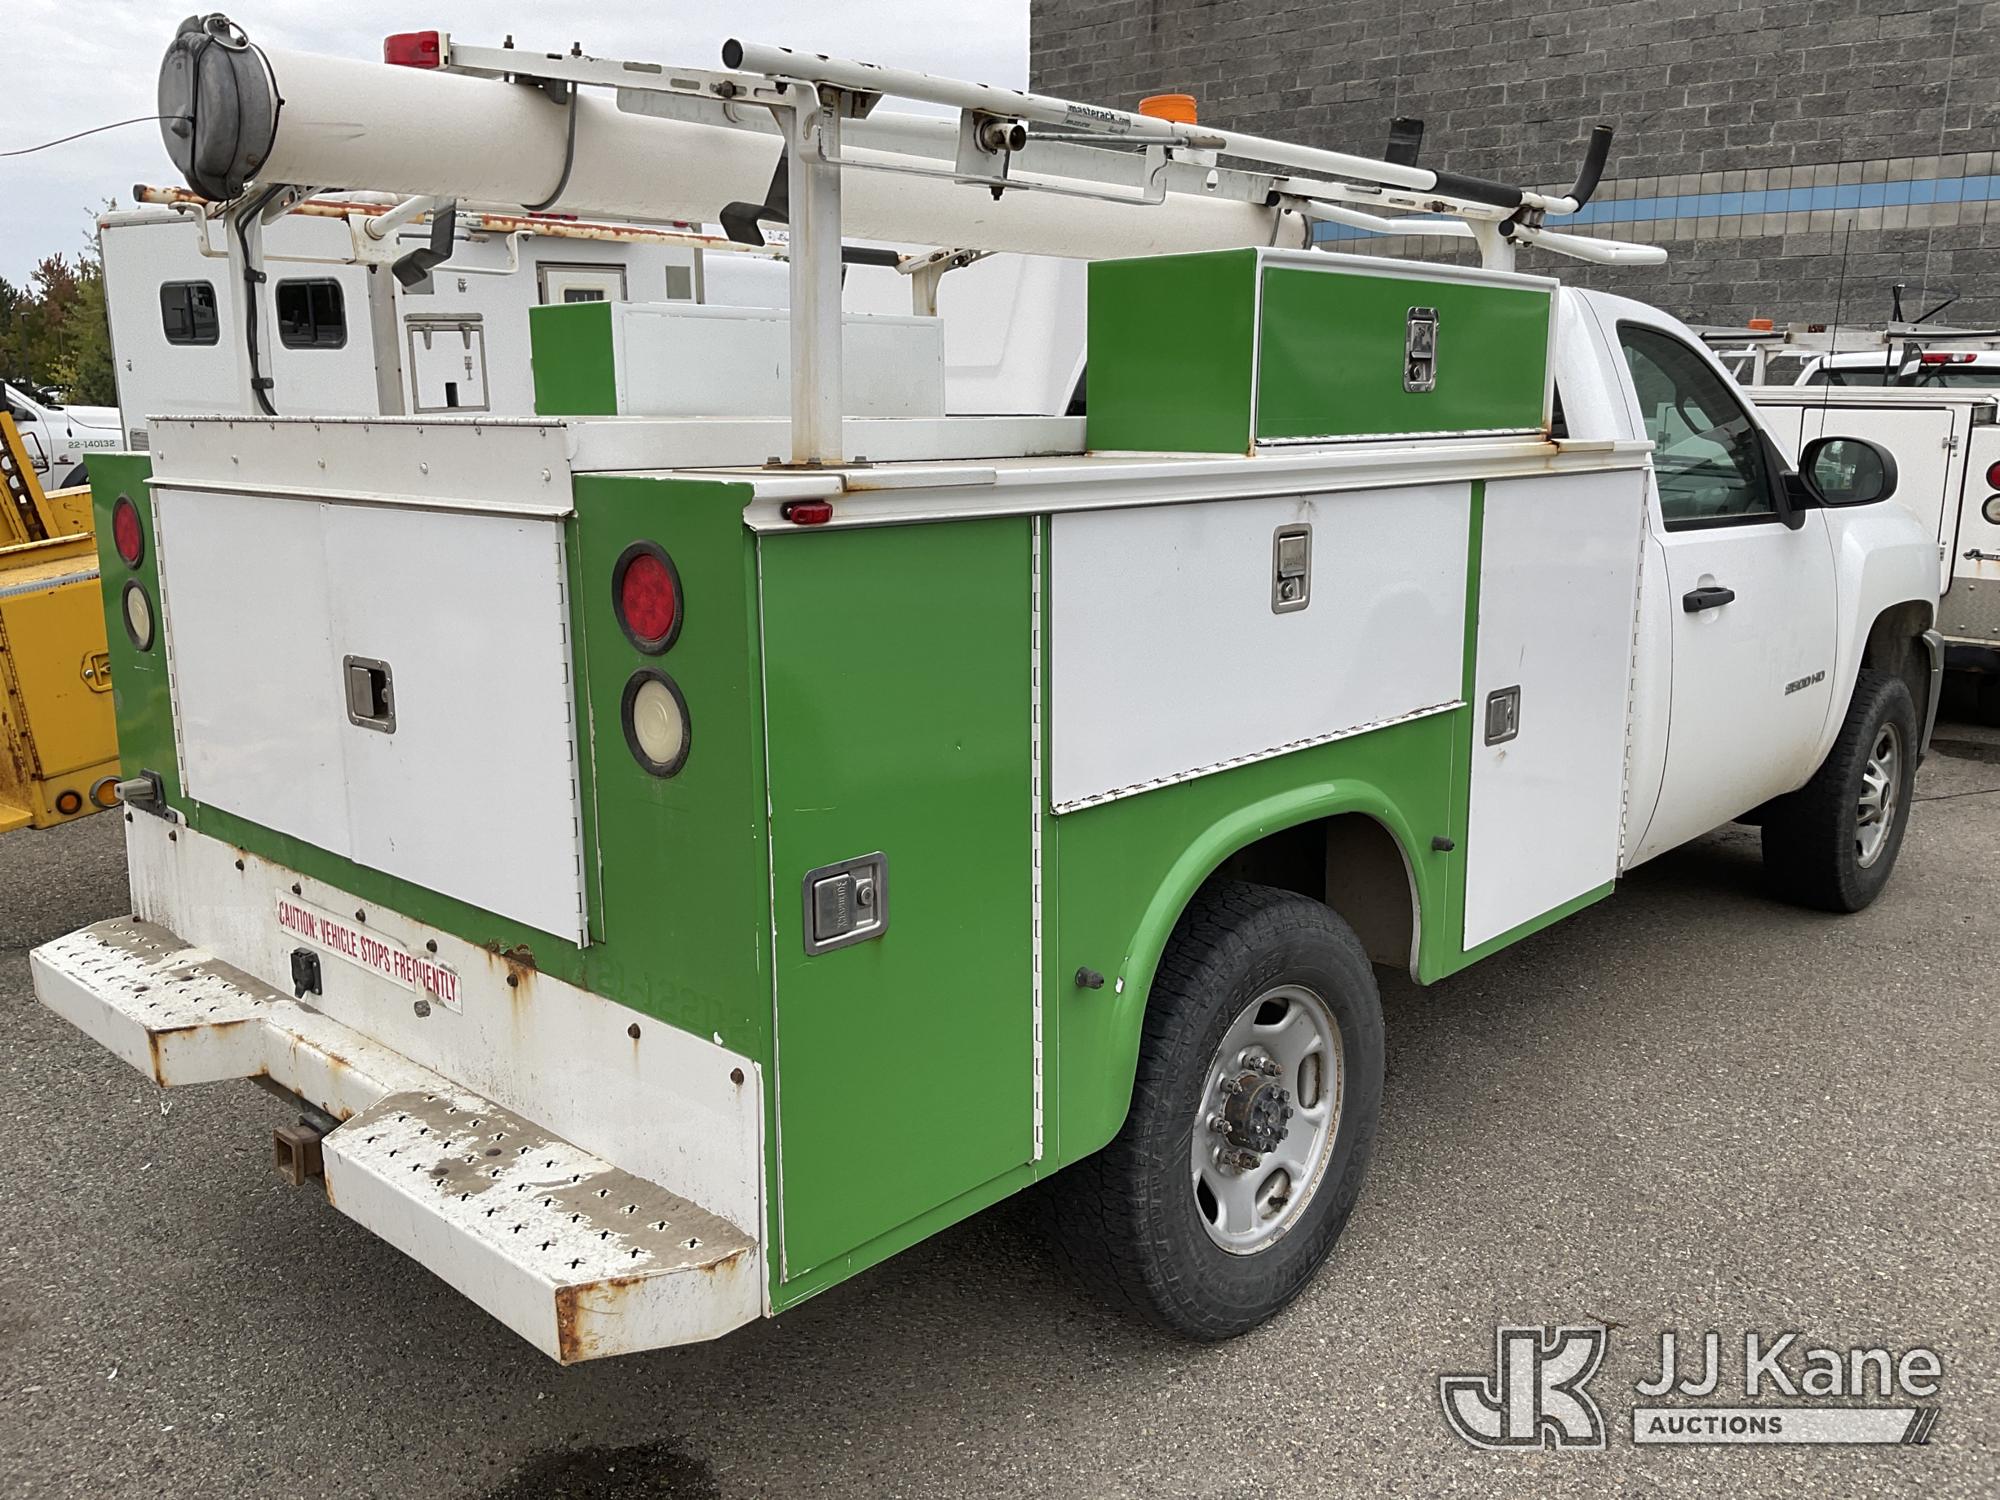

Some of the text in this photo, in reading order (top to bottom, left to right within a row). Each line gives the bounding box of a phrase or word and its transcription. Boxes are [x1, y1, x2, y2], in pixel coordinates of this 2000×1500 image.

[68, 440, 116, 449] 22-140132
[279, 901, 456, 1002] CAUTION: VEHICLE STOPS FREQUENTLY
